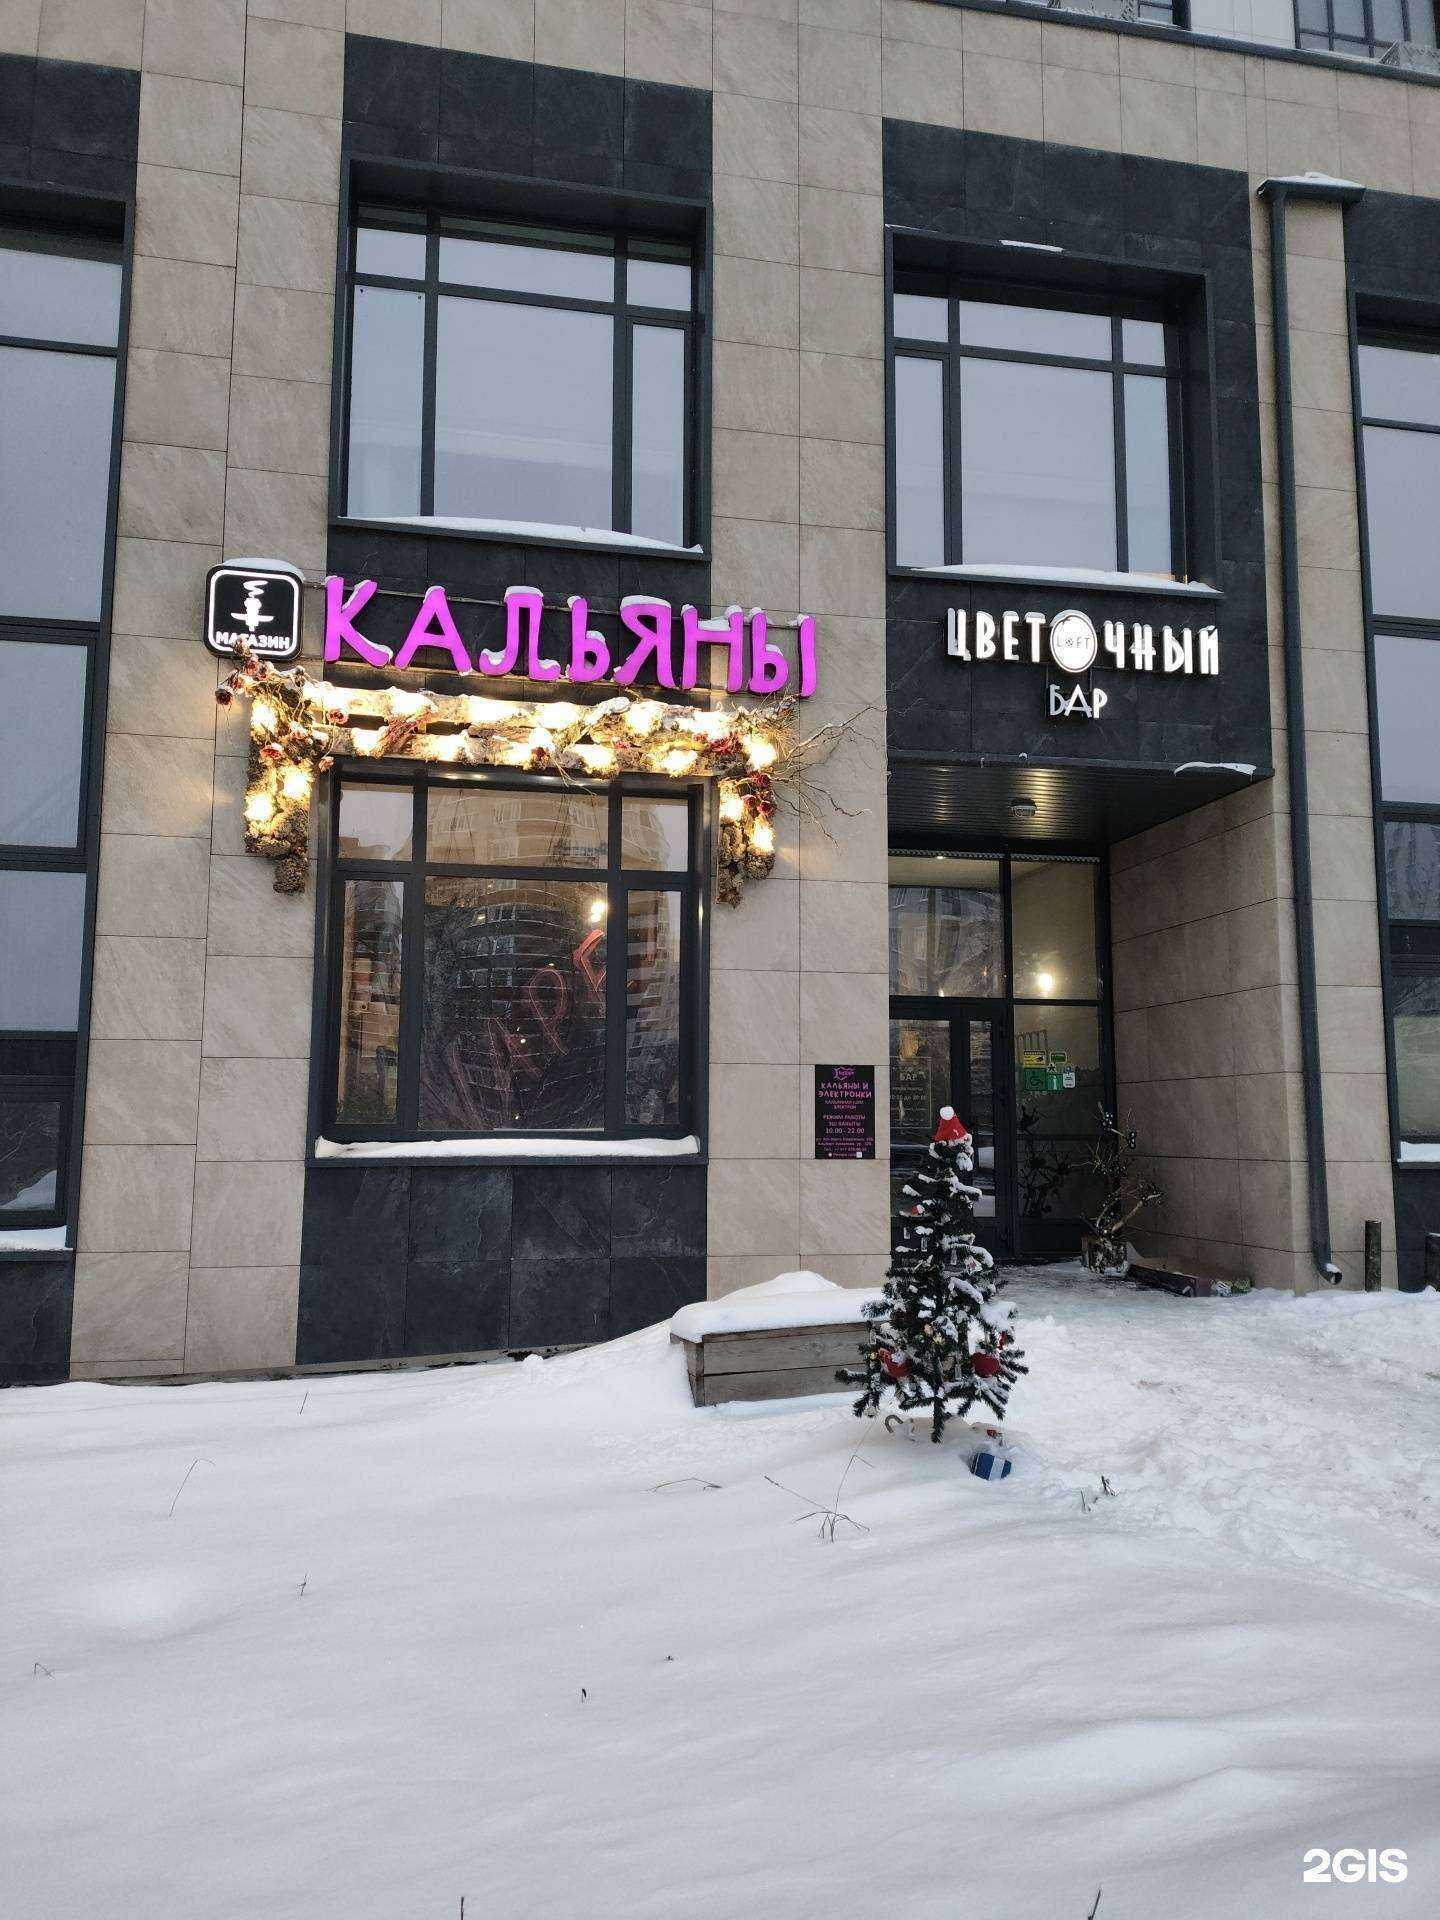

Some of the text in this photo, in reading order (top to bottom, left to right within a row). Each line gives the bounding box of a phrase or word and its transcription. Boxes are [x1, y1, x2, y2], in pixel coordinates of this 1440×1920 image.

[323, 576, 819, 698] КАЛЬЯНЫ
[1049, 684, 1108, 719] БАР
[818, 1090, 872, 1098] ЭЛЕКТРОНКИ
[821, 1082, 869, 1090] КАЛЬЯНЫ И
